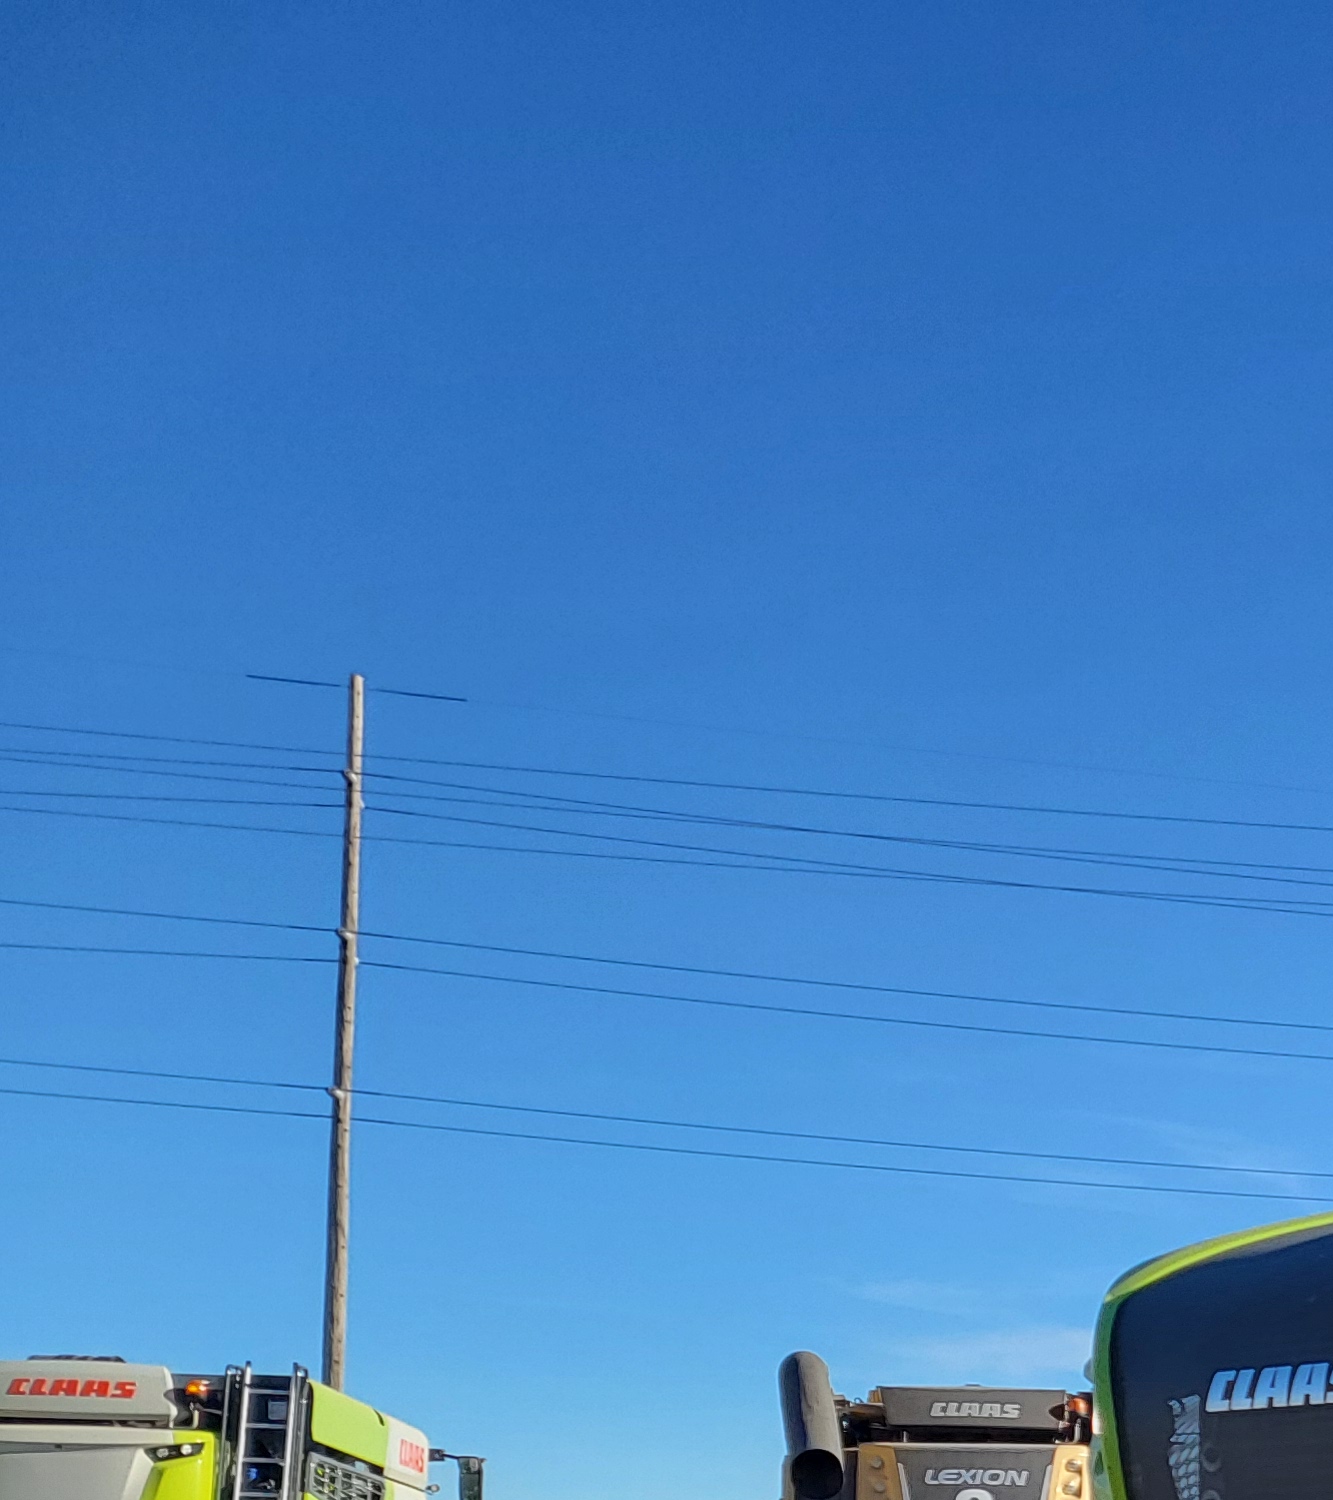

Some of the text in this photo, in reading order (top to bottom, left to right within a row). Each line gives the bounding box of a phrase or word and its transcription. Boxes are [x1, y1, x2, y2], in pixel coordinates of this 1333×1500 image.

[6, 1378, 137, 1399] CLAAS
[930, 1402, 1021, 1418] CLAAS
[925, 1469, 1029, 1486] LEXION
